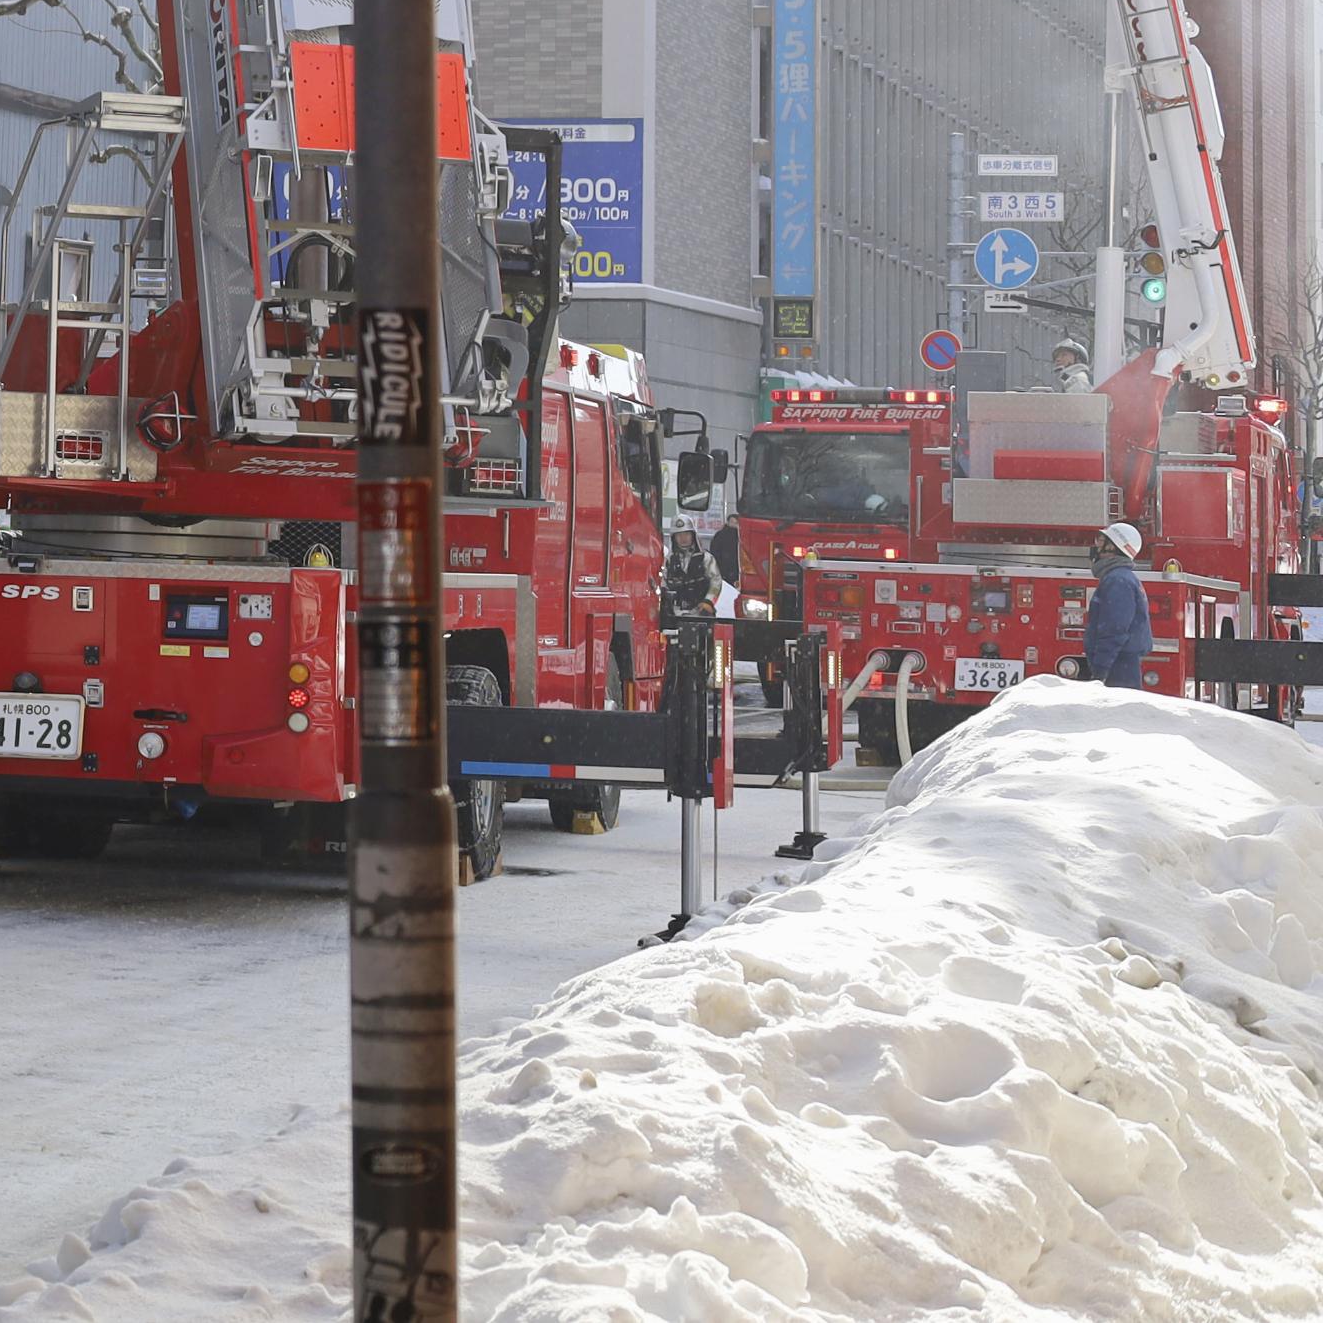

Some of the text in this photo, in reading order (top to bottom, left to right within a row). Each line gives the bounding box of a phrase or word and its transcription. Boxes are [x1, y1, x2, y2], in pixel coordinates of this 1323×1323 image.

[982, 160, 1052, 170] 歩車分離式信号
[987, 210, 1013, 218] South
[1025, 210, 1047, 218] West
[571, 251, 625, 277] 00円
[373, 311, 411, 440] RIDICULE
[782, 407, 943, 420] SAPPORO FIRE BUREAU
[241, 456, 339, 468] Sapporo
[229, 465, 361, 478] Fire Bureau
[813, 541, 845, 549] CLASS
[845, 540, 856, 549] A
[1, 584, 60, 600] SPS
[968, 670, 1019, 688] 36-84
